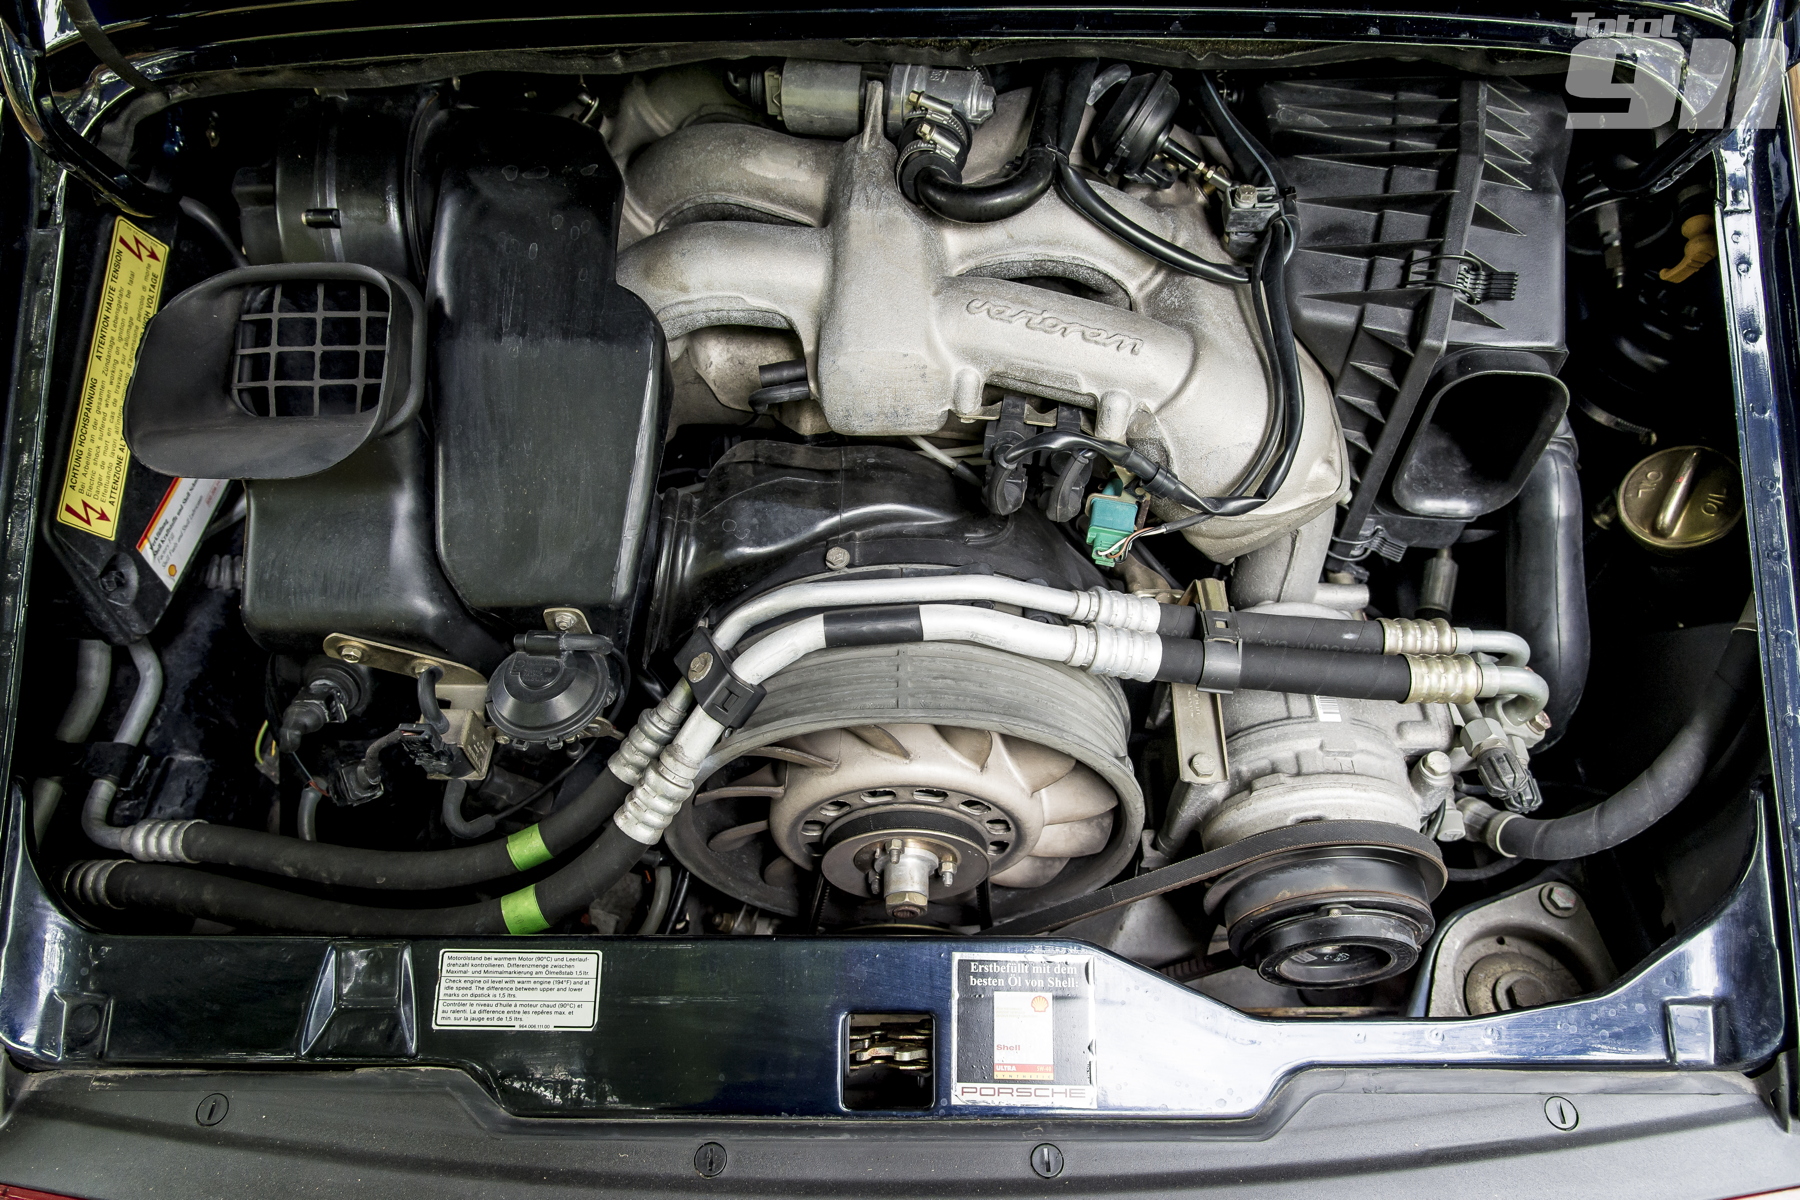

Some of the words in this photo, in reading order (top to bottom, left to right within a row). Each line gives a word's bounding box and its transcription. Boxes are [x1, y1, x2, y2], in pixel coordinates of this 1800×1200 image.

[95, 314, 110, 361] ATTENTION
[105, 285, 115, 313] HAUTE
[110, 248, 123, 283] TENSION
[146, 272, 158, 308] VOLTAGE
[69, 449, 83, 491] ACHTUNG
[78, 377, 97, 447] HOCHSPANNUNG
[81, 447, 92, 477] Arbeiten
[95, 380, 105, 414] gesamten
[101, 336, 115, 376] Zündanlage
[110, 286, 124, 332] Lebensgefahr
[85, 470, 96, 497] Electric
[92, 445, 100, 466] shock
[98, 411, 107, 441] suffered
[109, 358, 119, 385] working
[117, 318, 125, 342] ignition
[93, 473, 102, 500] Danger
[114, 369, 123, 394] travaux
[122, 316, 134, 350] l'allumage
[100, 462, 113, 503] Effettuando
[109, 438, 117, 458] lavori
[136, 295, 145, 322] pericolo
[108, 455, 123, 506] ATTENZIONE
[970, 962, 1029, 974] Erstbefüllt
[1032, 963, 1051, 974] mit
[1054, 964, 1077, 975] dem
[970, 976, 1005, 986] besten
[1008, 974, 1022, 987] Öl
[1025, 979, 1045, 987] von
[1047, 977, 1079, 988] Shell:
[961, 1087, 1086, 1098] PORSCHE
